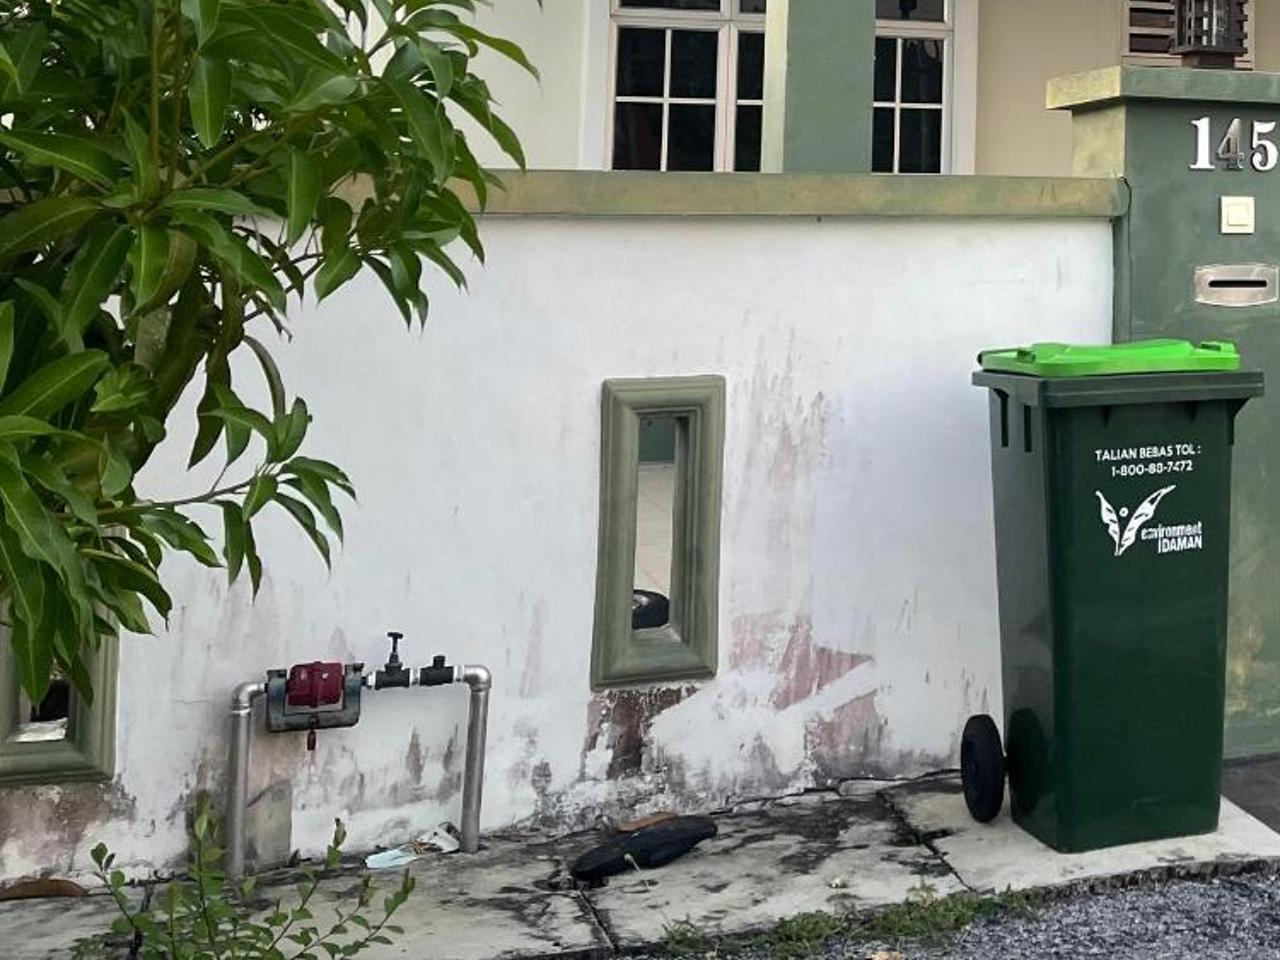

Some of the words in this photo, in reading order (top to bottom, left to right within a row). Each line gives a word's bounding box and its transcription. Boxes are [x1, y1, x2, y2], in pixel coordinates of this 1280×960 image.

[1189, 117, 1279, 171] 145
[1095, 448, 1138, 461] TALIAN
[1140, 446, 1173, 459] BEBAS
[1158, 535, 1202, 553] IDAMAN
